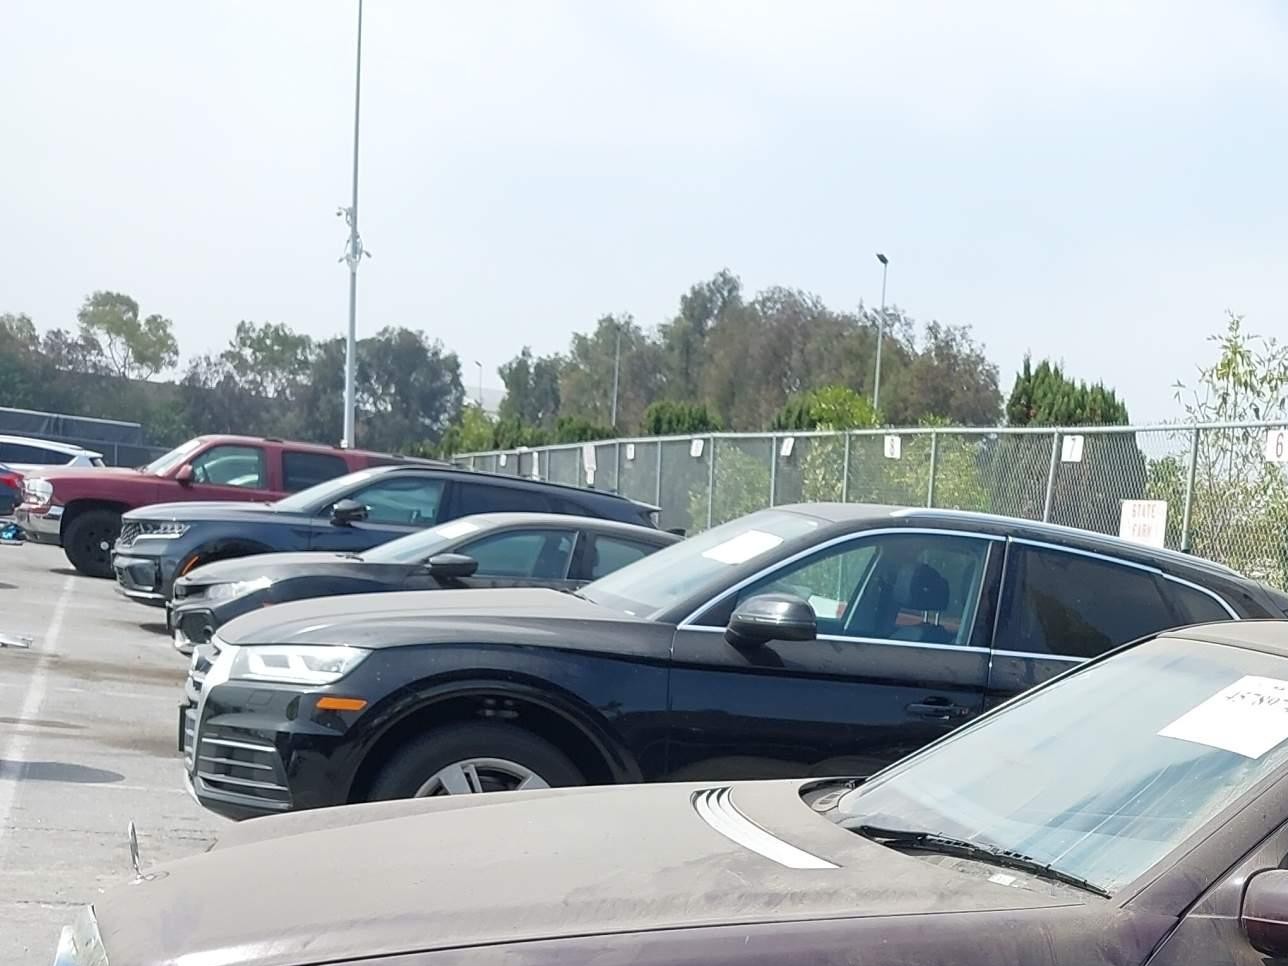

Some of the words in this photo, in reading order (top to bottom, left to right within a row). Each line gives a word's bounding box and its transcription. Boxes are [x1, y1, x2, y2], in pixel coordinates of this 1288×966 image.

[1069, 437, 1077, 459] 7
[1275, 432, 1284, 457] 6
[1132, 503, 1157, 519] STATE
